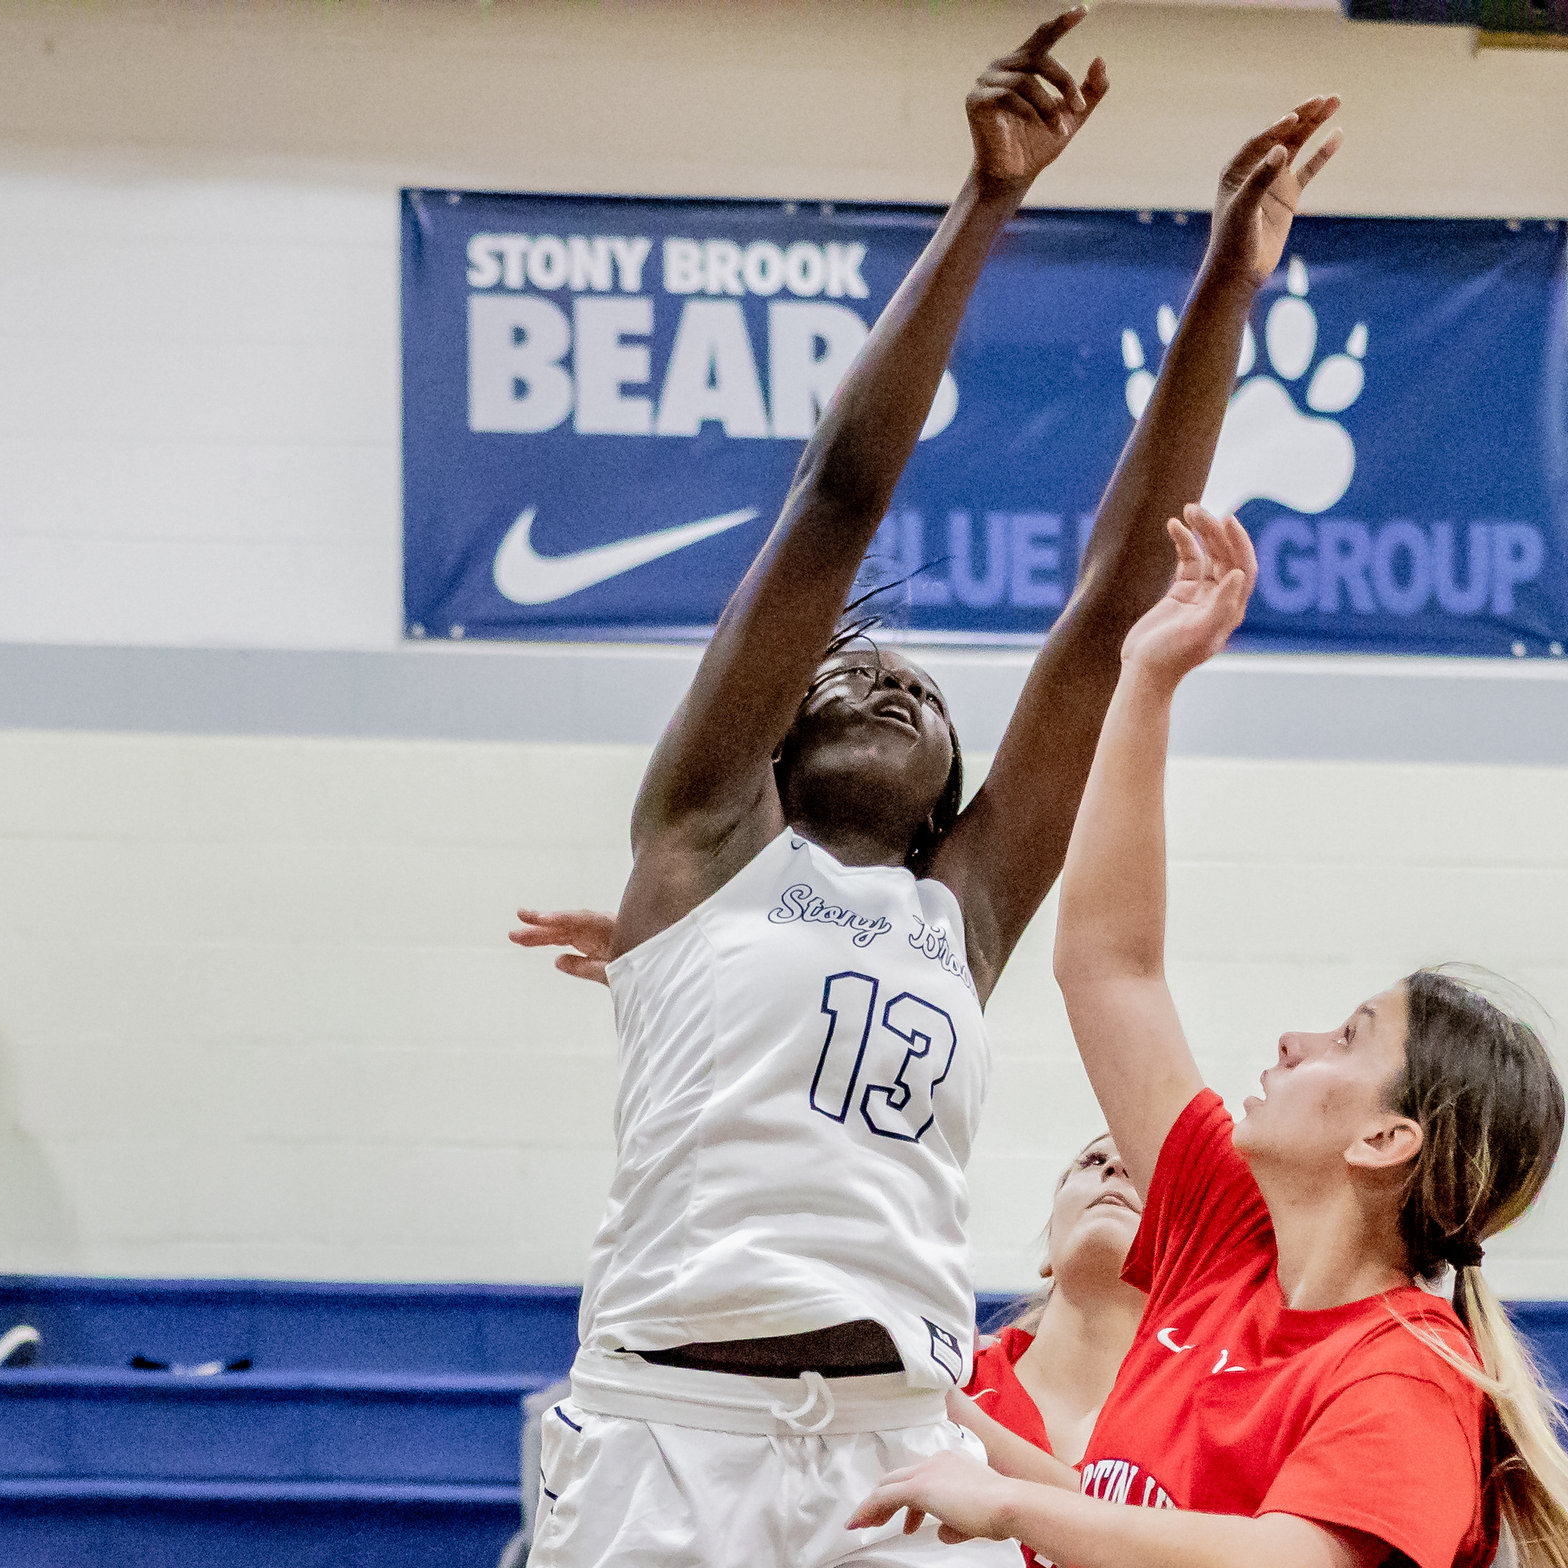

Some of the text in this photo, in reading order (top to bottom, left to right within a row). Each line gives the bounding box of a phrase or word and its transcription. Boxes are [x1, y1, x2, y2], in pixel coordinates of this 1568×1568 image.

[466, 233, 870, 298] STONY BROOK
[467, 293, 959, 440] BEAR
[1257, 516, 1544, 616] GROUP
[767, 883, 892, 948] Stony
[809, 970, 957, 1142] 13
